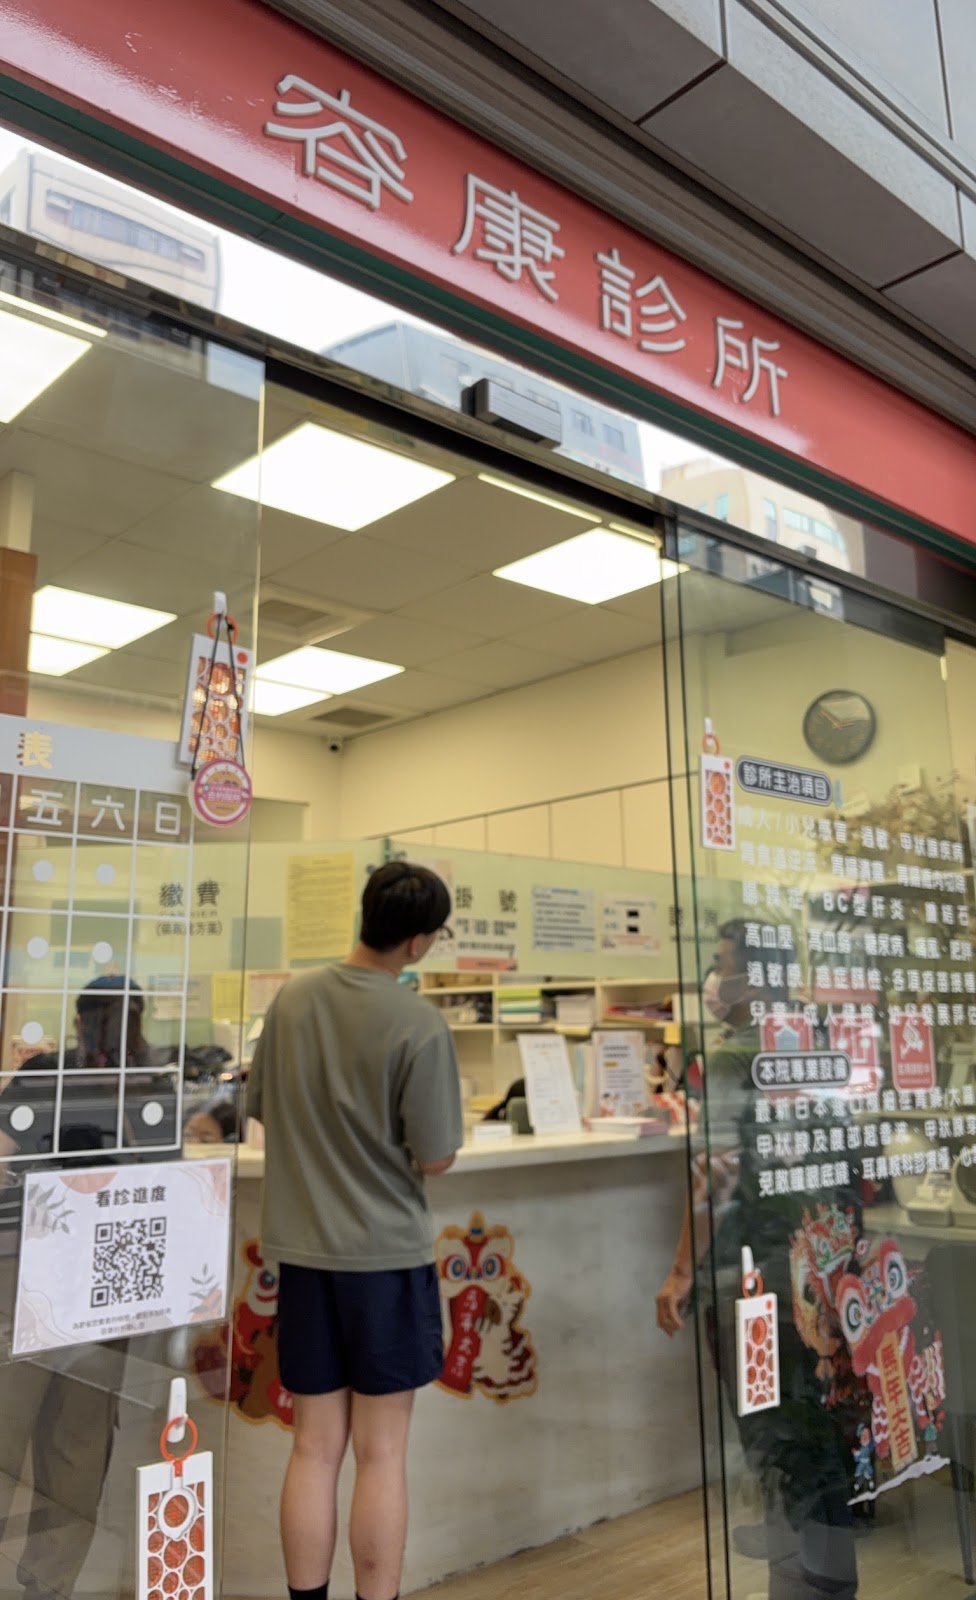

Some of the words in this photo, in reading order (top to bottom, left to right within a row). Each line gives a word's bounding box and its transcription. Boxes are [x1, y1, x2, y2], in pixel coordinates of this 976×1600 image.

[265, 74, 788, 416] 容康診所
[17, 731, 53, 770] 表
[742, 763, 829, 801] 診所主治項目
[27, 789, 63, 826] 五
[91, 795, 125, 831] 六
[155, 802, 181, 835] 日
[159, 877, 221, 907] 繳費
[759, 1056, 848, 1083] 本院專業設備
[95, 1186, 167, 1208] 看診進度
